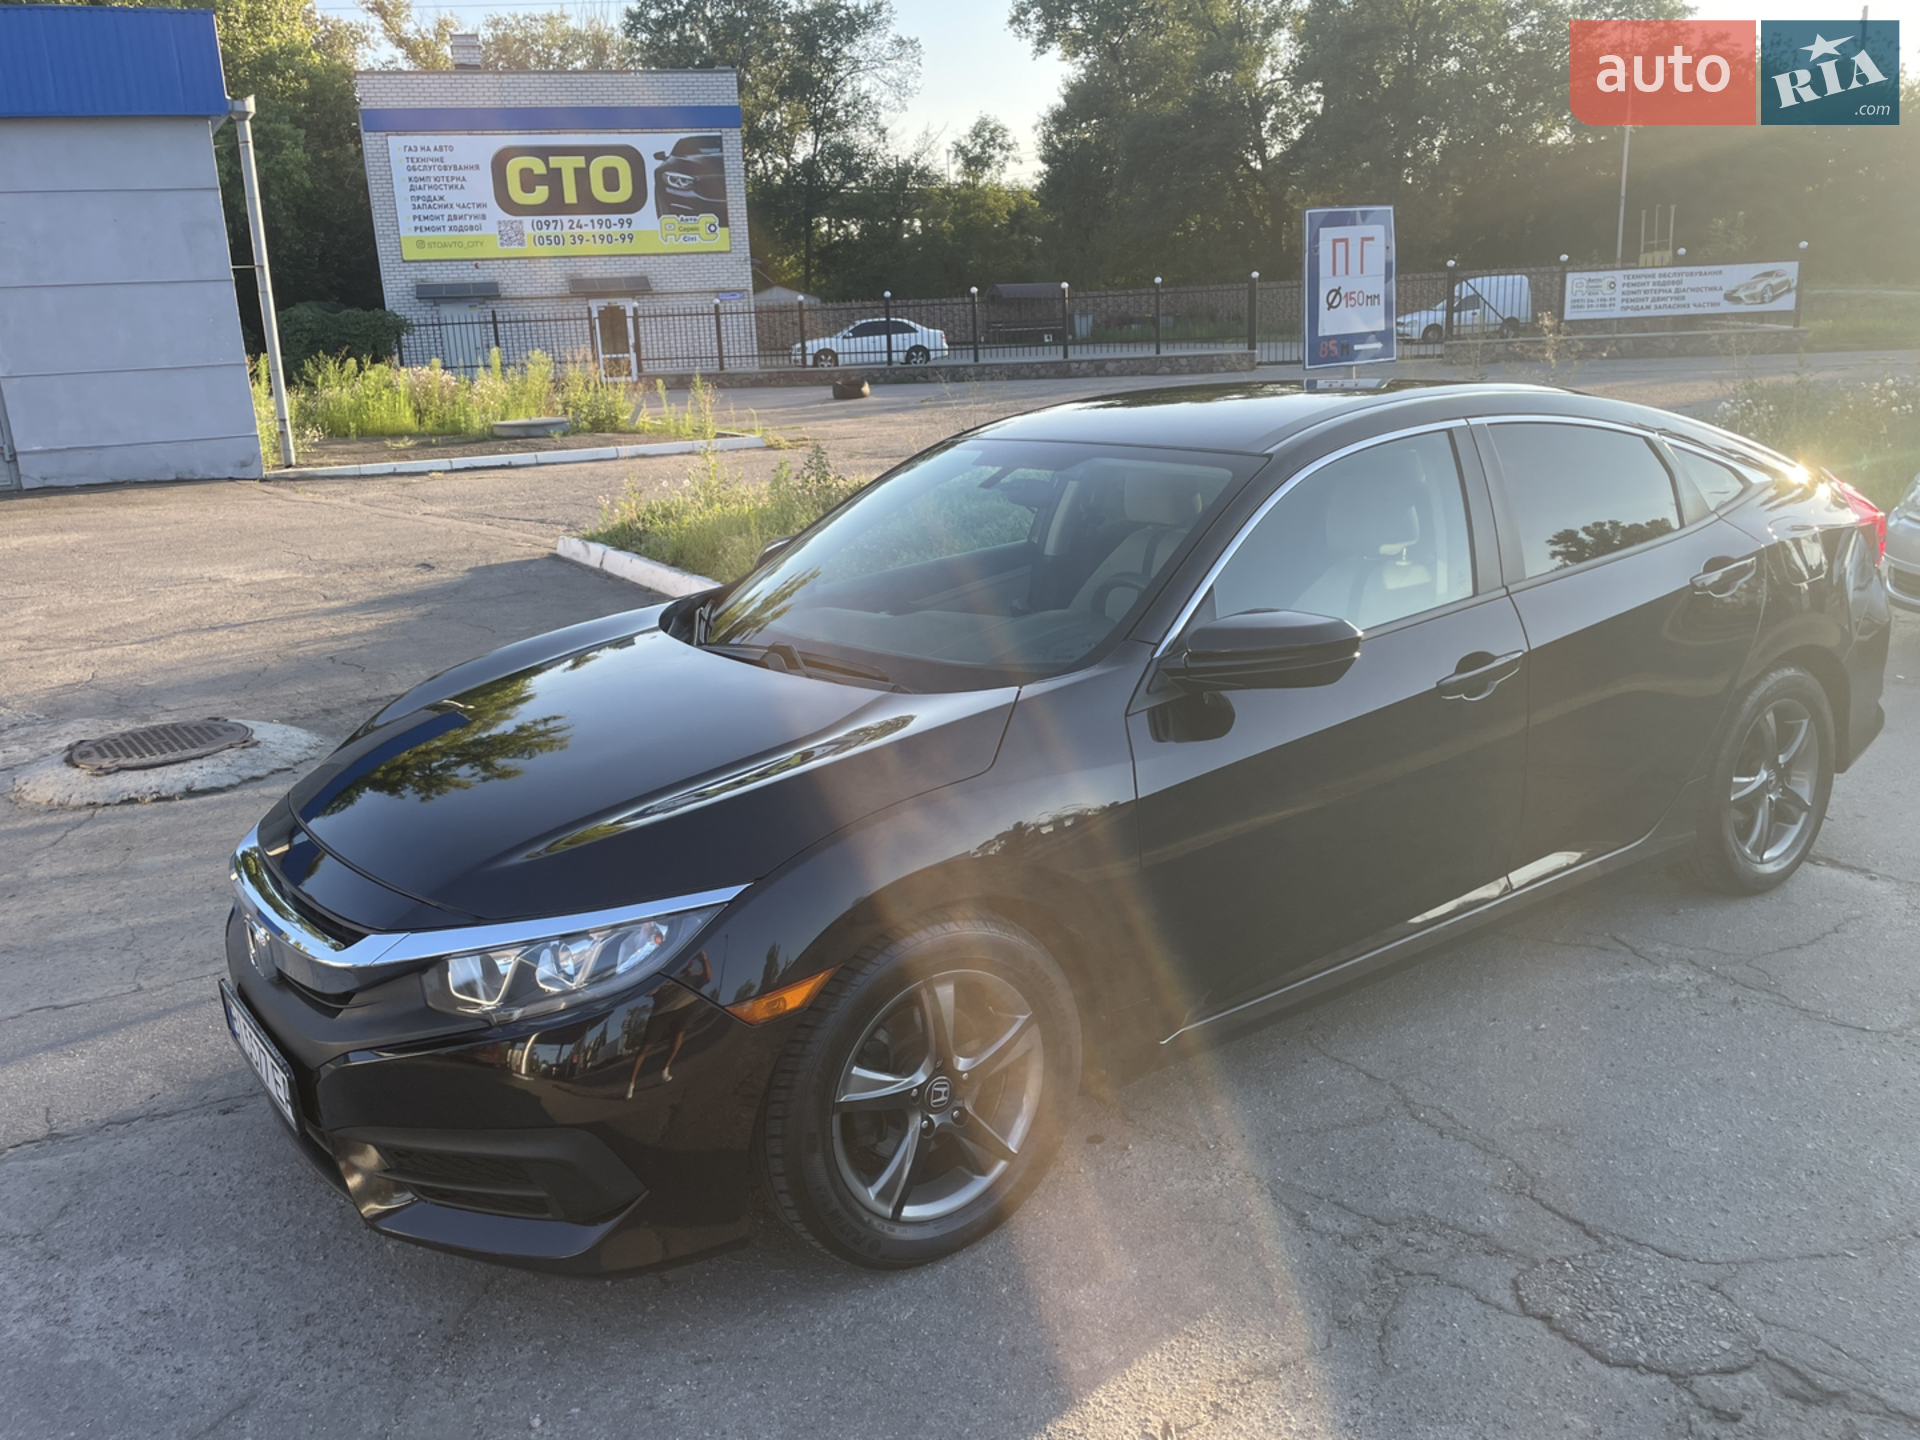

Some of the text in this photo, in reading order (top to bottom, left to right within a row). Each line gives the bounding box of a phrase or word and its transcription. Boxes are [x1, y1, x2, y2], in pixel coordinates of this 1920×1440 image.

[406, 163, 480, 172] ОБСЛУГОВУВАННЯ
[506, 155, 633, 205] СТО
[409, 184, 465, 192] ДІАГНОСТИКА
[410, 195, 446, 203] ПРОДАЖ
[412, 213, 487, 222] РЕМОНТ ДВИГУНІВ
[448, 223, 483, 232] ХОДОВОЇ
[531, 218, 633, 232] (097) 24-190-99
[532, 233, 635, 247] (050) 39-190-99
[1319, 339, 1338, 358] 85
